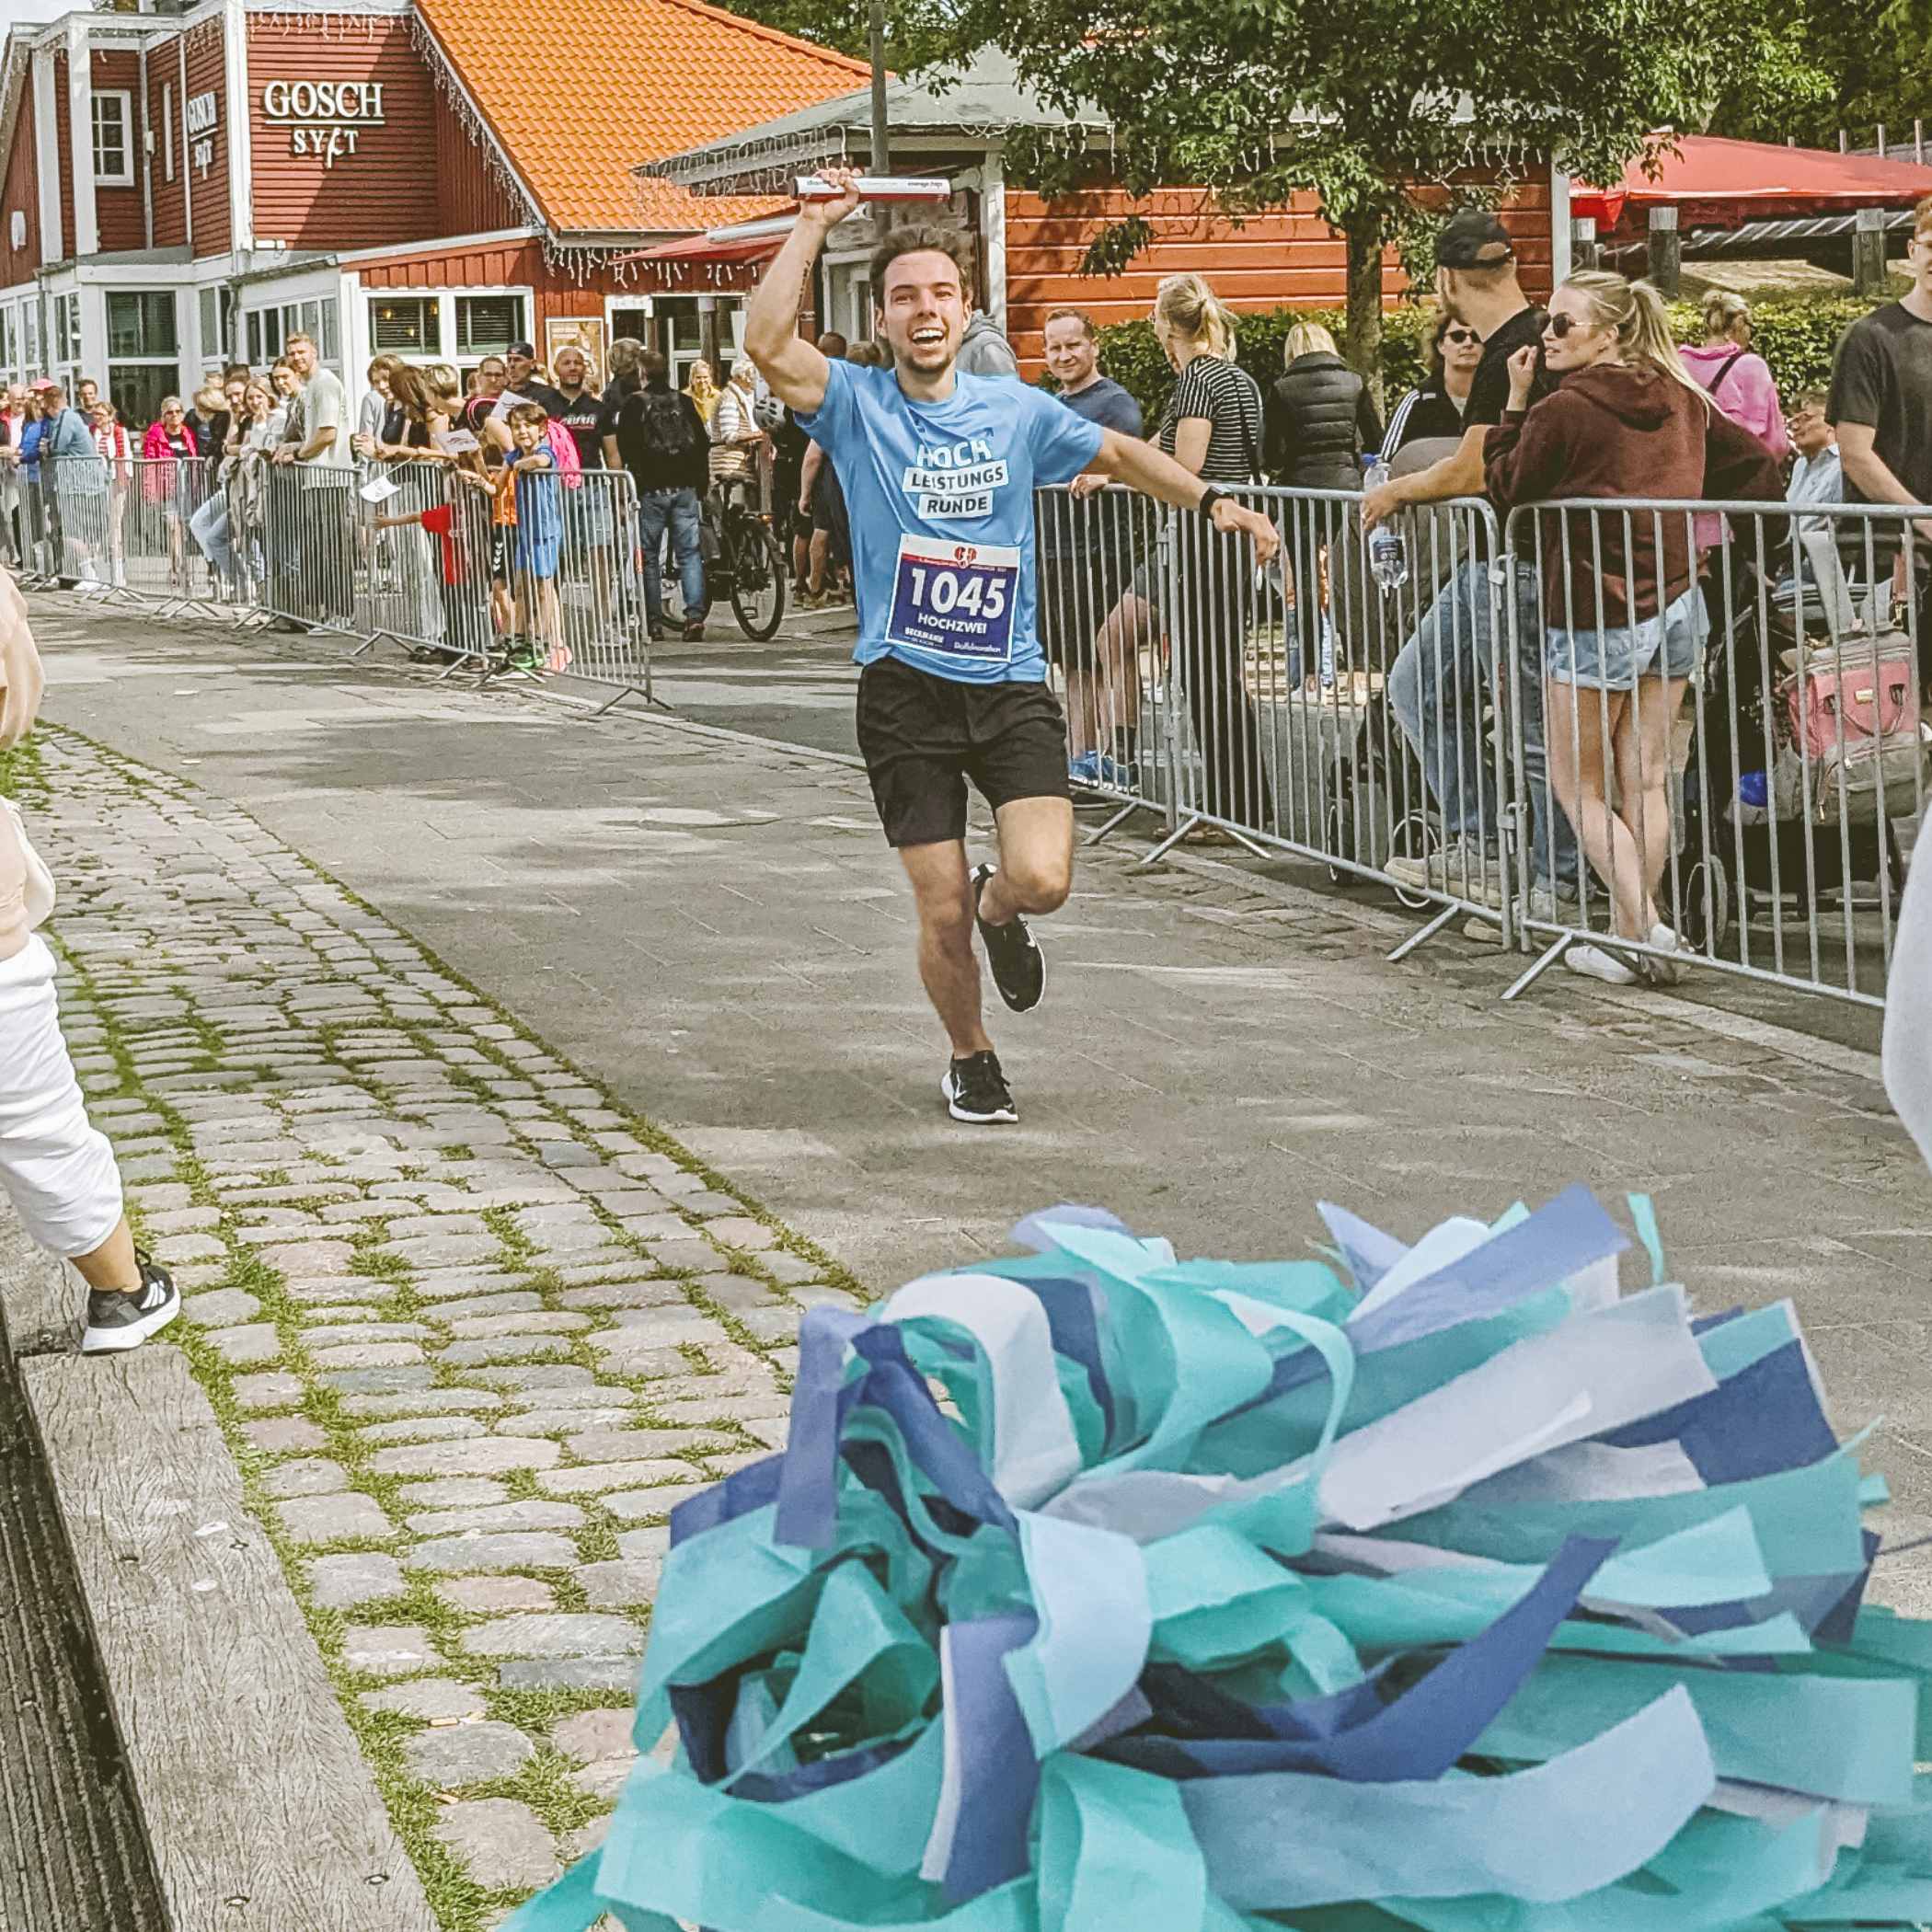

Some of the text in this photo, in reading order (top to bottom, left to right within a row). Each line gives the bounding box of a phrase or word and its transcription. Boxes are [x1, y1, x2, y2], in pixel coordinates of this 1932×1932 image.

[264, 80, 385, 118] GOSCH
[916, 440, 993, 468] HOCH
[911, 466, 1004, 490] LEISTUNGS
[926, 496, 987, 513] RUNDE
[912, 568, 1007, 619] 1045
[917, 613, 987, 634] HOCHZWEI
